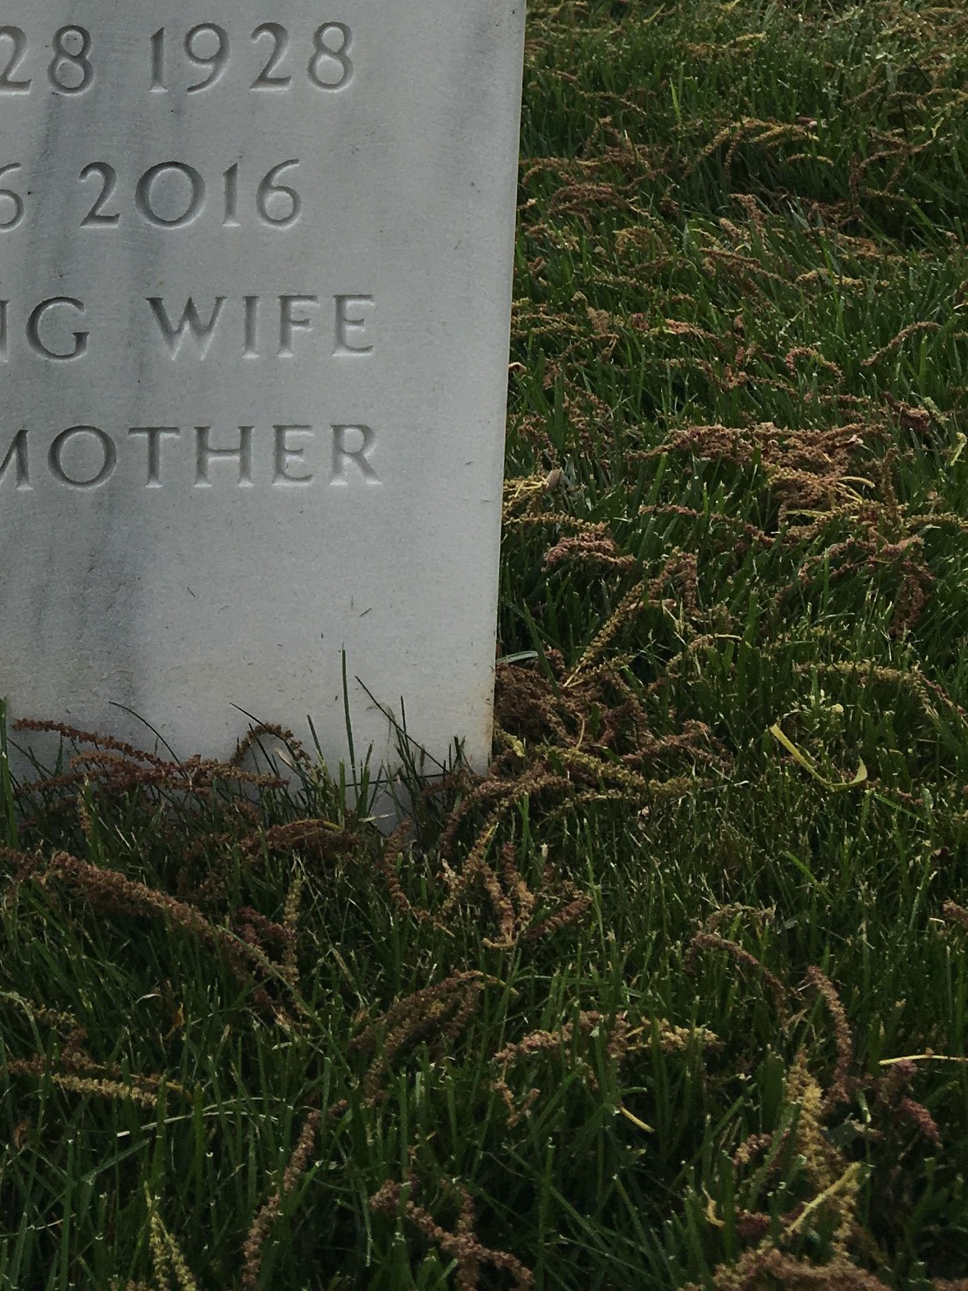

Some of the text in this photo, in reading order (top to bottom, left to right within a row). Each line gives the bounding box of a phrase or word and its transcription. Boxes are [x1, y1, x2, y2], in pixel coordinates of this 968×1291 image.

[148, 21, 355, 94] 1928
[79, 159, 302, 229] 2016
[146, 293, 376, 361] WIFE
